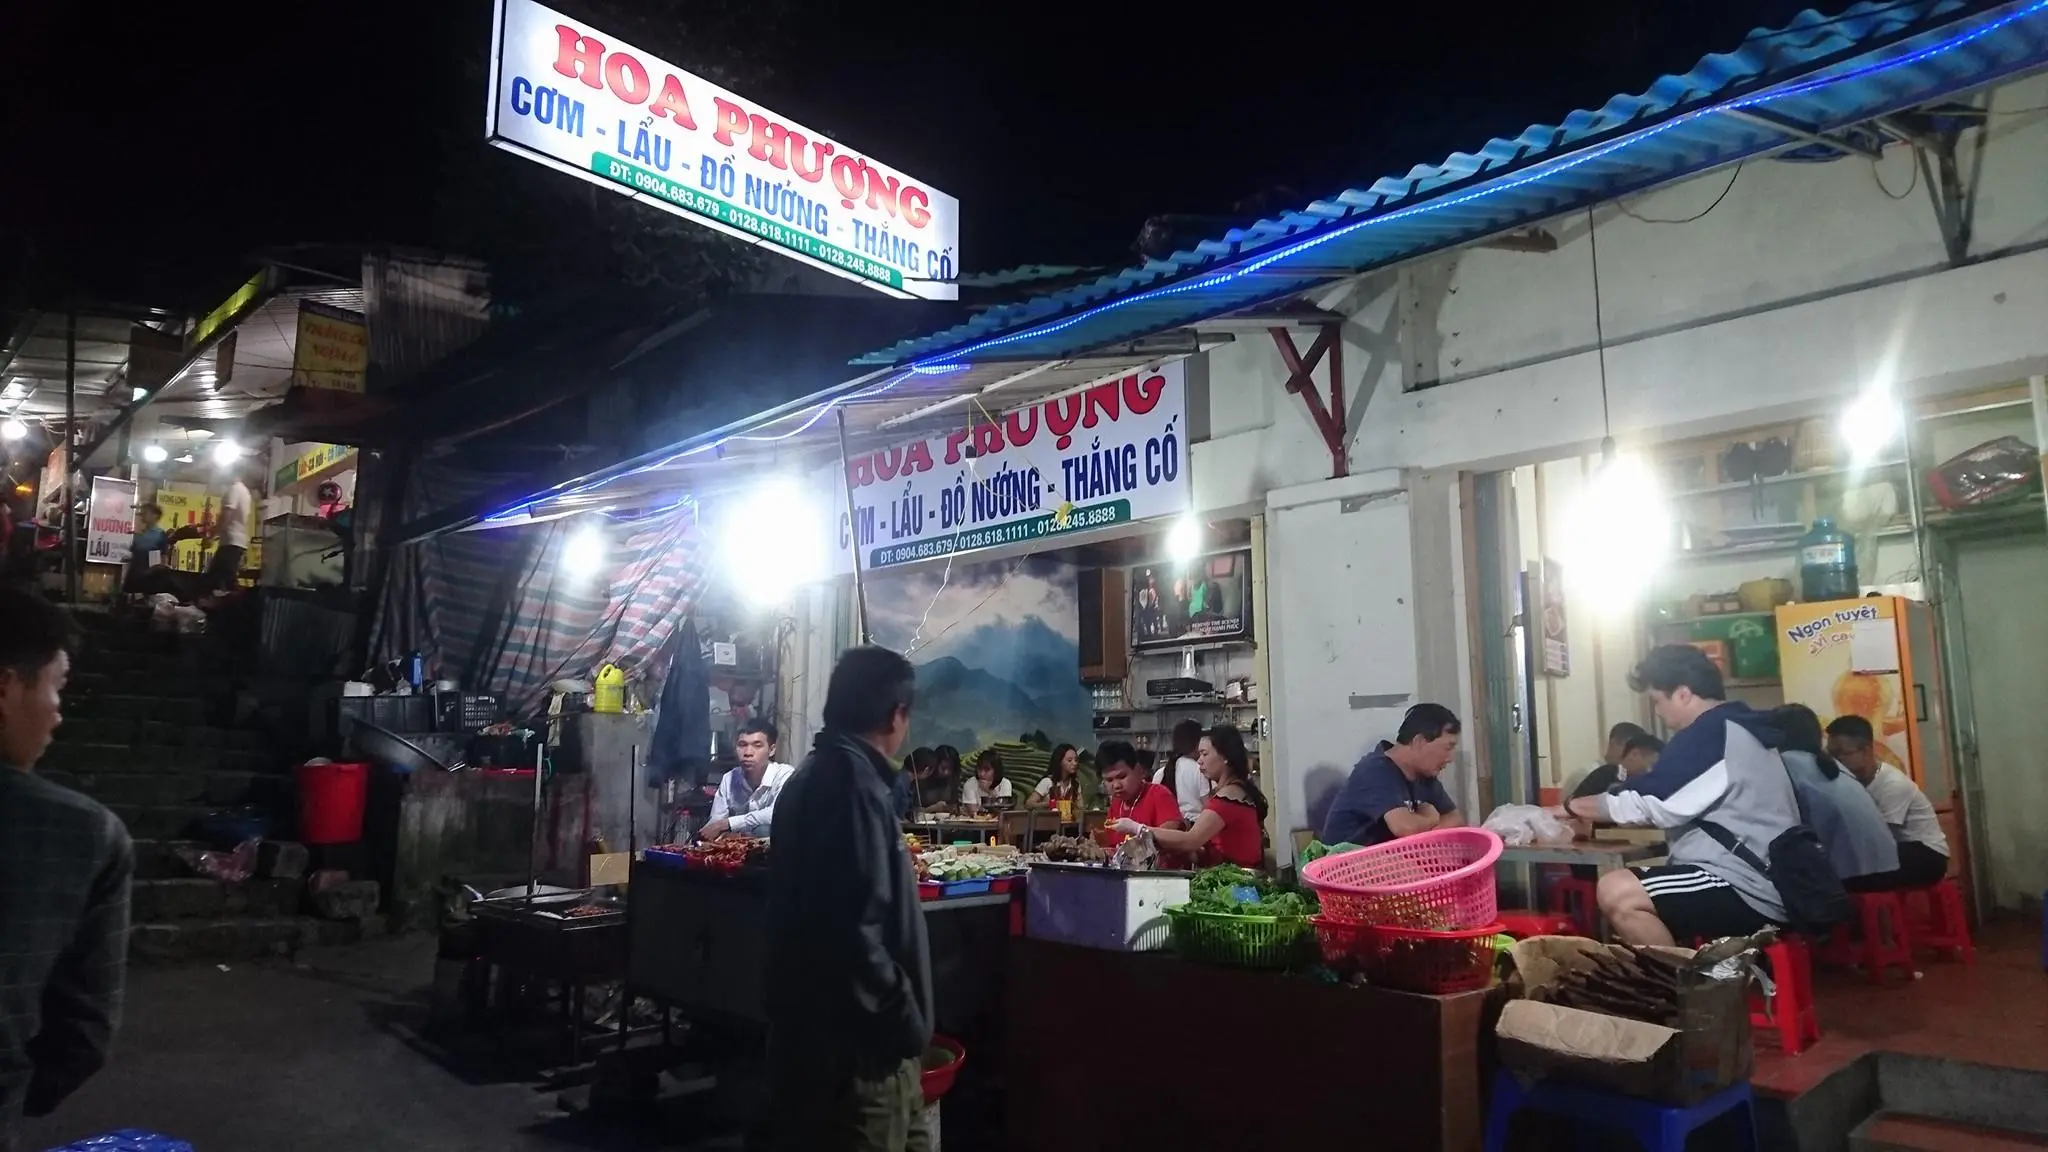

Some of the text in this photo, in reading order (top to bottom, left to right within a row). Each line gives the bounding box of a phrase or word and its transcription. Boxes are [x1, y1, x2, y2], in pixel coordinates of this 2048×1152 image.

[511, 76, 585, 138] CƠM
[617, 116, 671, 172] LẨU
[701, 154, 736, 198] ĐỒ
[745, 180, 828, 237] NƯỚNG
[553, 24, 931, 228] HOA PHƯỢNG
[609, 161, 632, 183] ĐT:
[635, 172, 720, 217] 0904.683.679
[729, 208, 809, 253] 0128.618.1111
[819, 245, 891, 283] 0128.245.8888
[891, 480, 923, 539] LẨU
[941, 470, 966, 529] ĐỒ
[972, 461, 1041, 523] NƯỚNG
[1062, 436, 1137, 503] THẮNG
[1145, 414, 1178, 486] CỐ
[896, 541, 952, 560] 0904.683.679
[960, 524, 1029, 549] 0128.618.1111
[1788, 618, 1832, 642] Ngon
